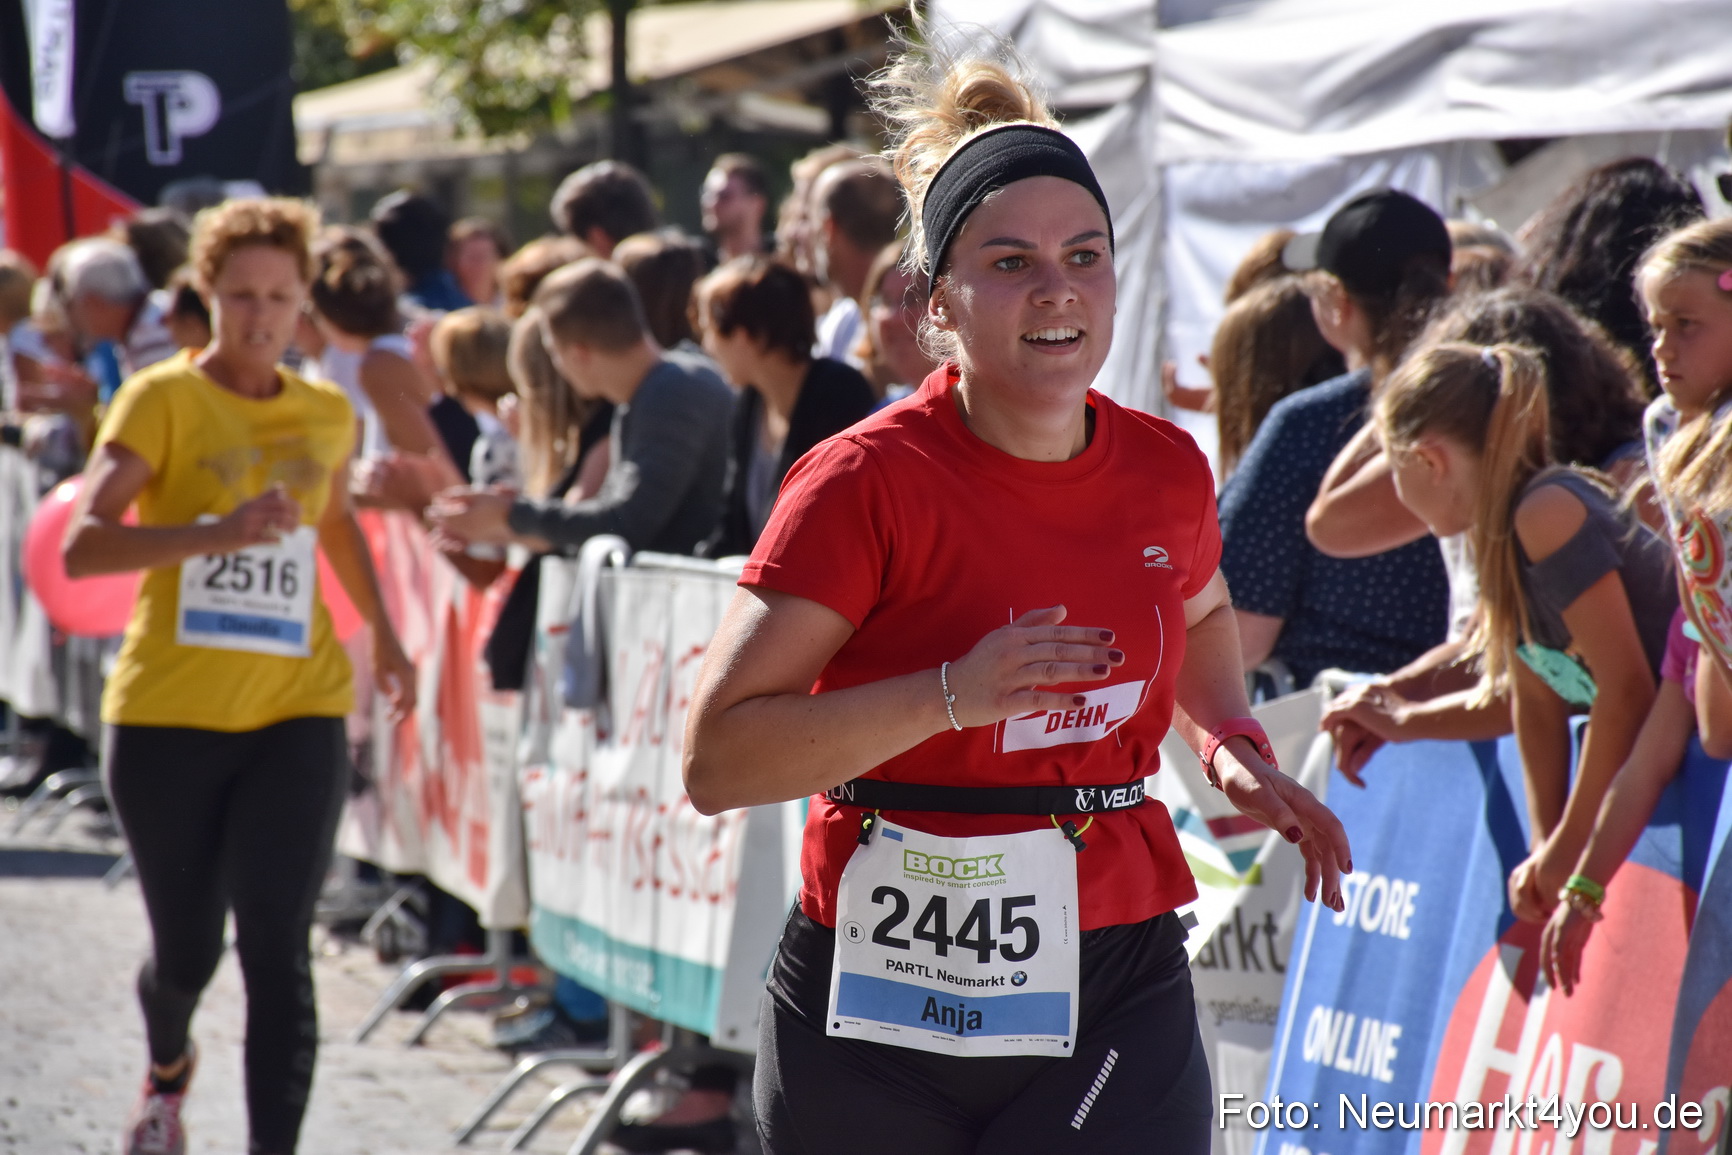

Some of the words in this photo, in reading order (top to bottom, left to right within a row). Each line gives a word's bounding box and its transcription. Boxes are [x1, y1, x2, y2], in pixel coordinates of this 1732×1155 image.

[204, 553, 299, 598] 2516
[1044, 702, 1110, 734] DEHN
[903, 848, 1006, 880] BOCK
[903, 872, 934, 884] inspired
[935, 878, 946, 888] by
[947, 880, 971, 889] smart
[972, 876, 1007, 888] concepts
[1332, 870, 1420, 939] STORE
[850, 926, 859, 939] B
[871, 885, 1041, 964] 2445
[1190, 904, 1286, 974] arkt
[885, 958, 933, 980] PARTL
[936, 961, 1005, 988] Neumarkt
[920, 996, 983, 1035] Anja
[1302, 1004, 1402, 1083] ONLINE
